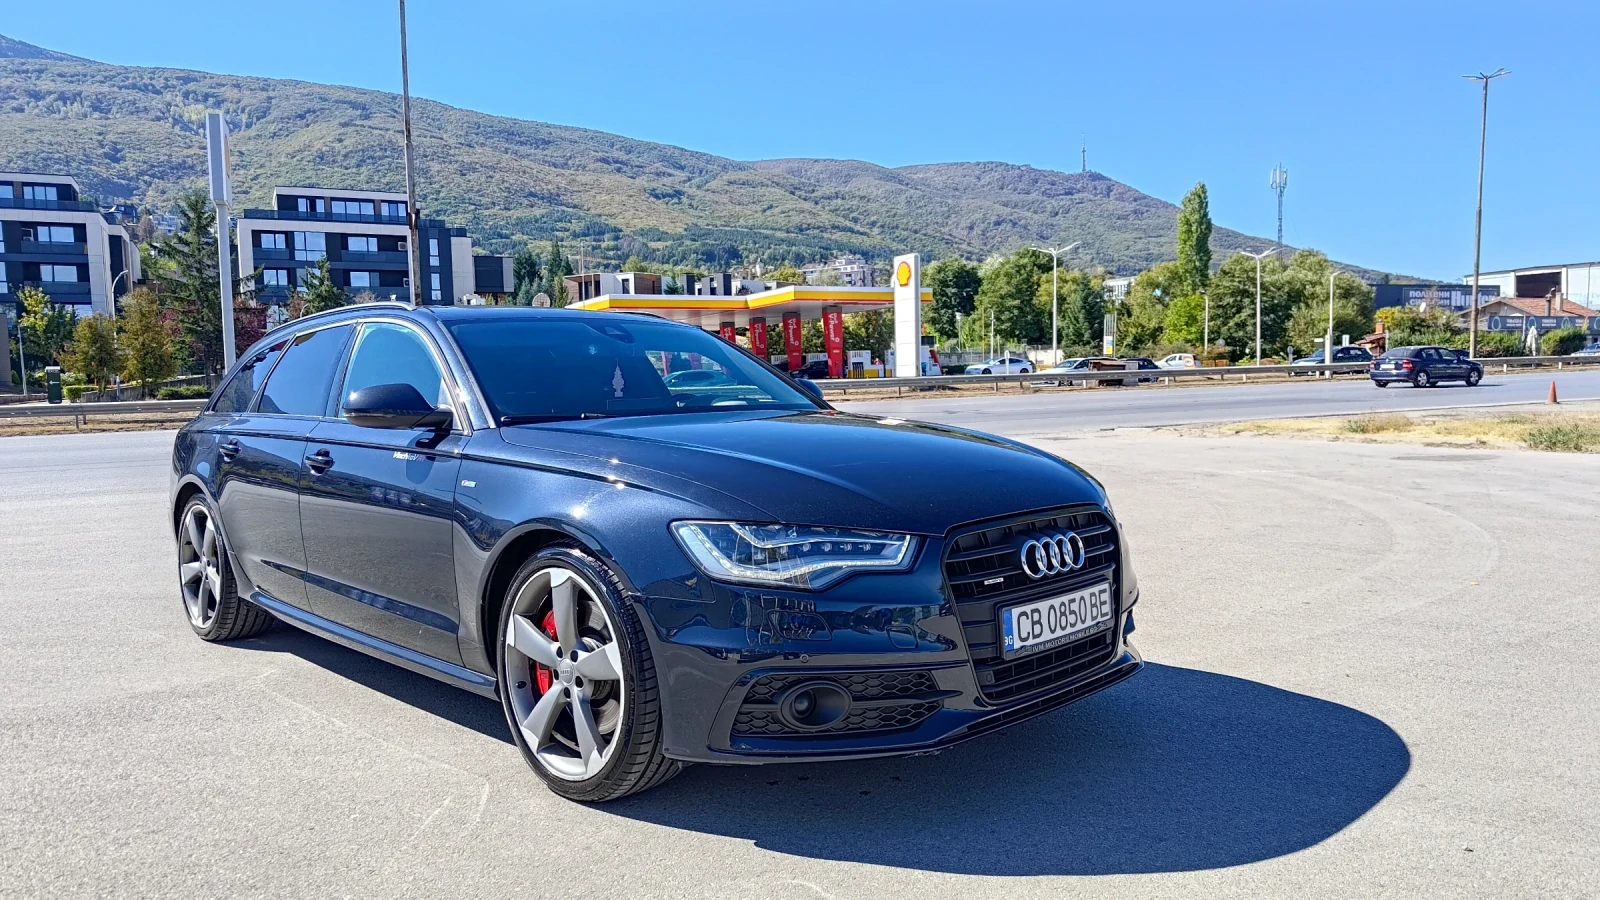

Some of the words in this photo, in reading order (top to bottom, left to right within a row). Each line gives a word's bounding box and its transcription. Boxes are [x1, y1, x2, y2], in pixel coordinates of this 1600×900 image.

[1017, 607, 1043, 643] CB
[1047, 595, 1087, 634] 0850
[1089, 588, 1109, 622] BE
